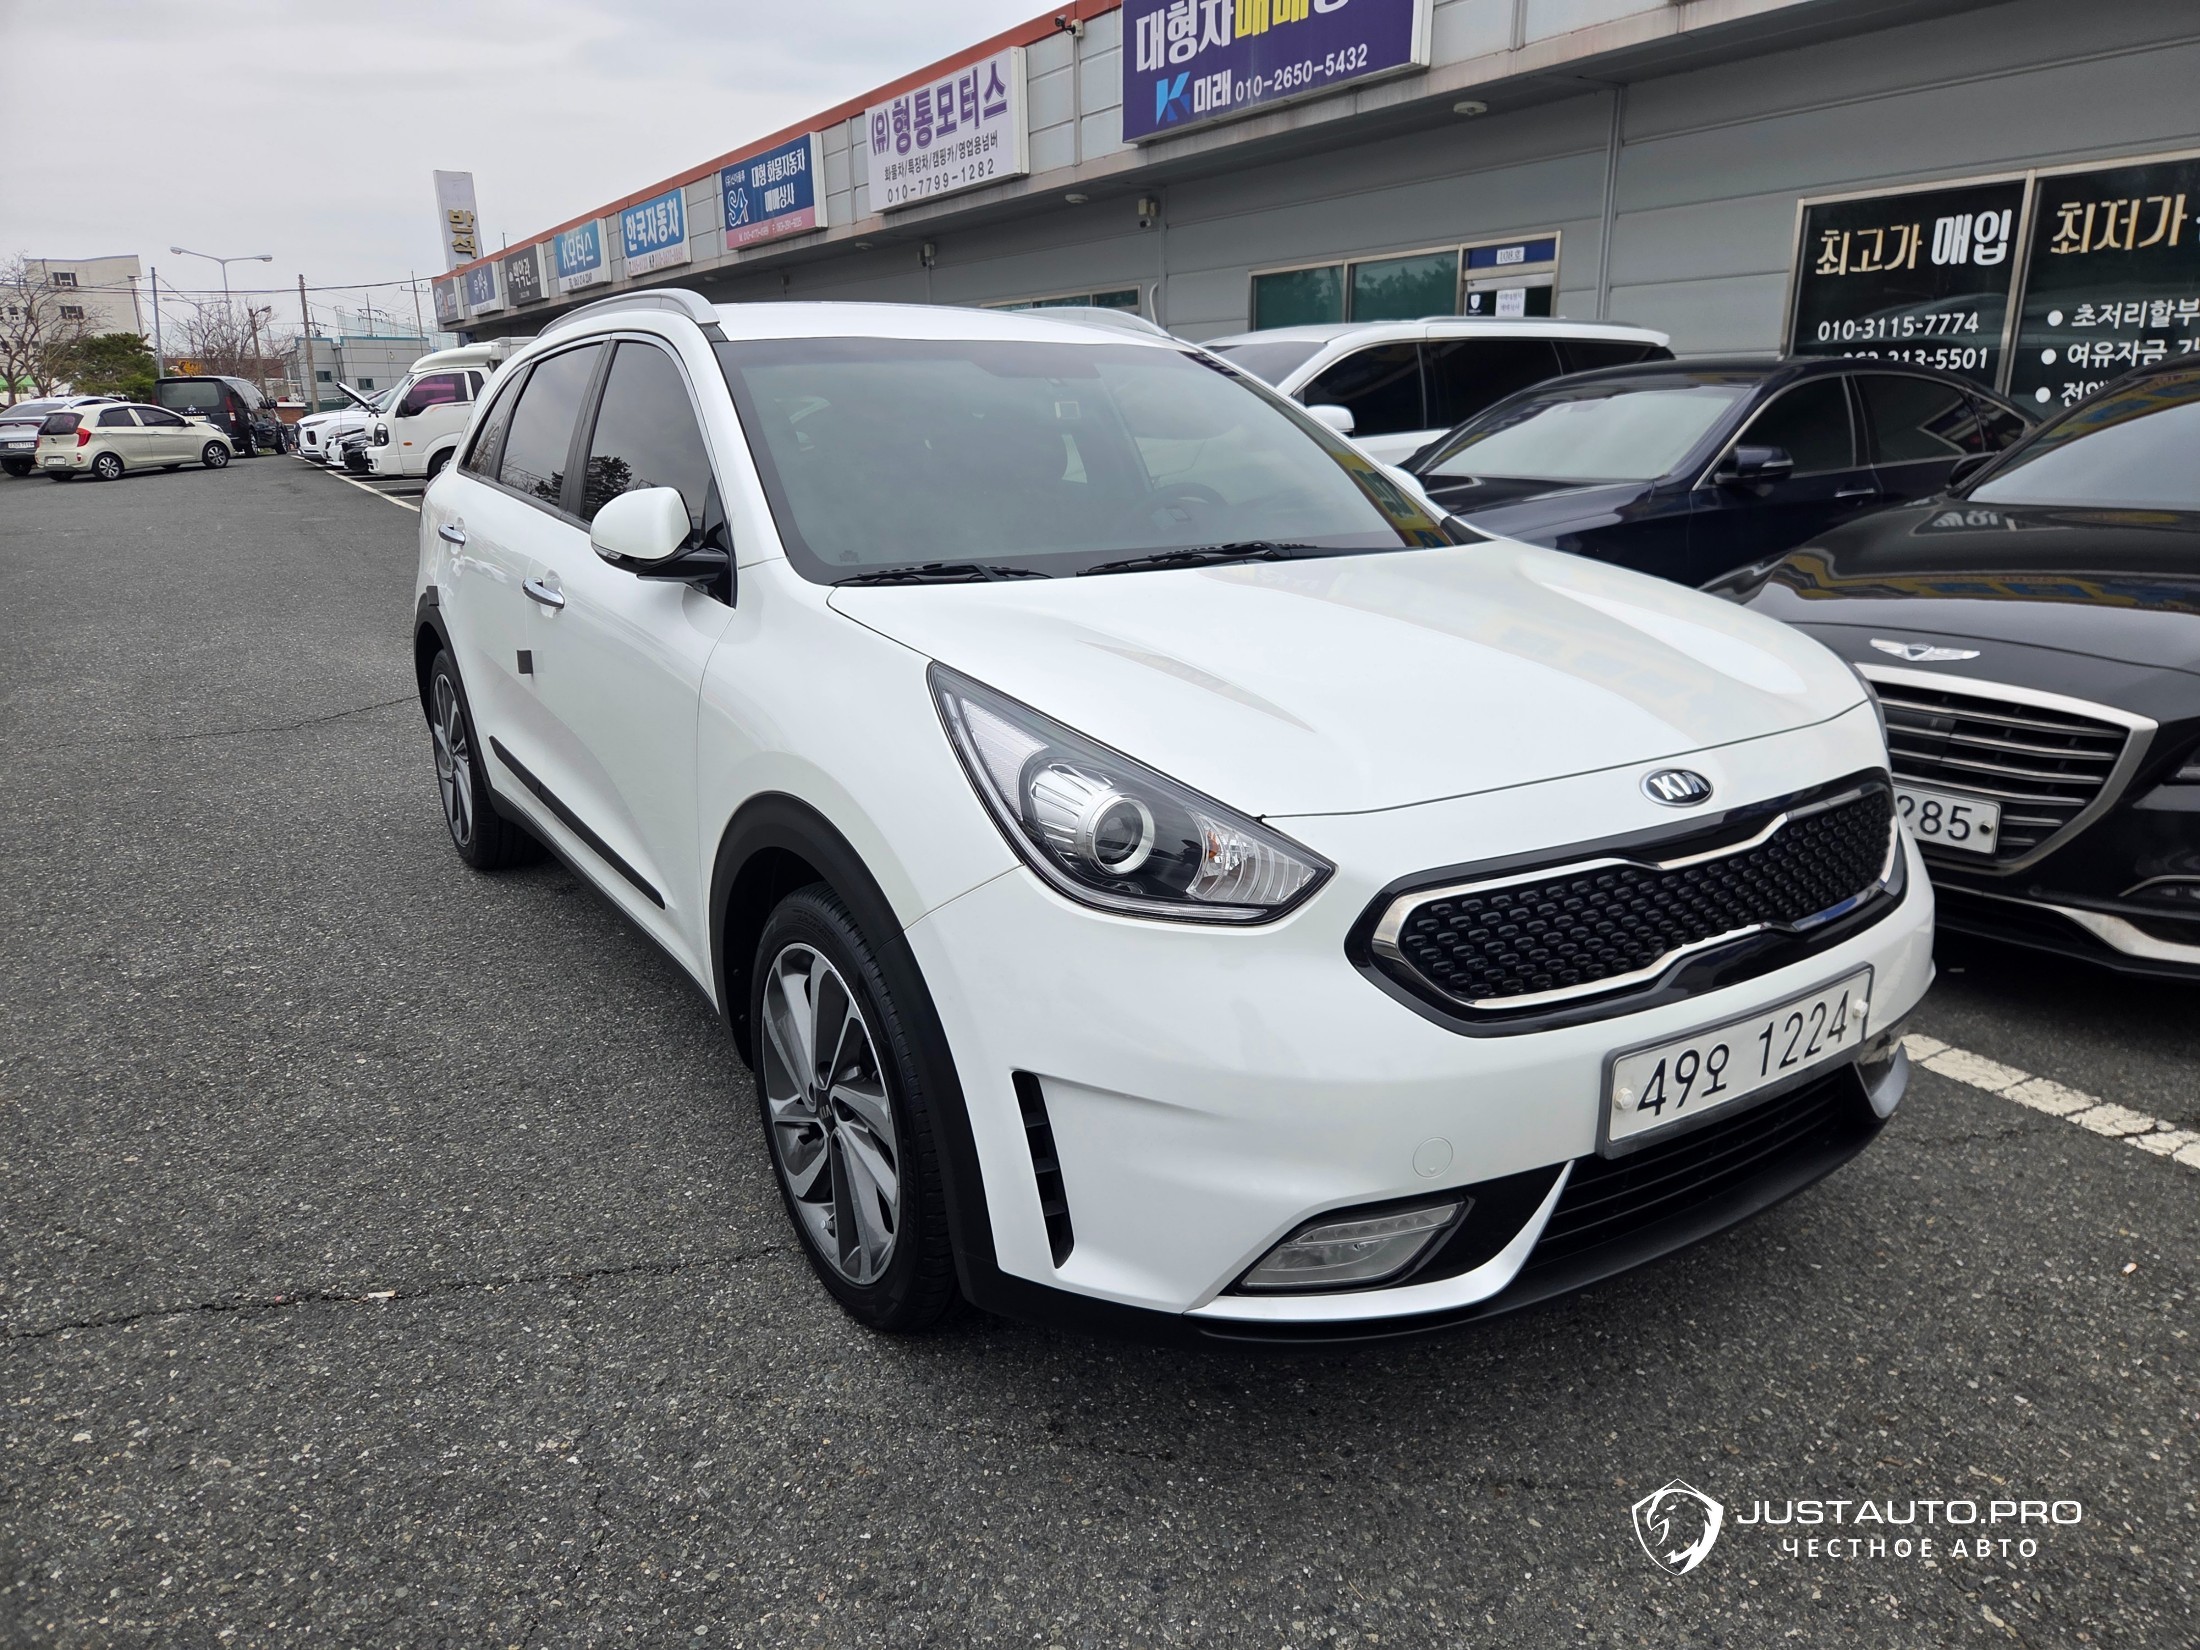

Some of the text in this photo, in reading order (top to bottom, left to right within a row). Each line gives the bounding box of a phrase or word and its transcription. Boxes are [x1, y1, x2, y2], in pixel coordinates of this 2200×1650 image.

[1193, 43, 1368, 113] 미래 010-2650-5432
[871, 60, 1008, 156] (유)형통모터스
[751, 147, 806, 188] 대형 화물자동차
[887, 158, 994, 203] 010-7799-1282
[764, 182, 795, 213] 매매상사
[448, 209, 478, 269] 반석
[626, 197, 679, 251] 한국자동차
[1815, 208, 2013, 276] 최고가 매입
[2050, 193, 2188, 256] 최저가
[1817, 311, 1980, 342] 010-3115-7774
[2071, 298, 2200, 330] 초저리할부
[2067, 339, 2168, 369] 여유자금
[1649, 771, 1710, 800] KIA
[1637, 989, 1850, 1116] 49오 1224
